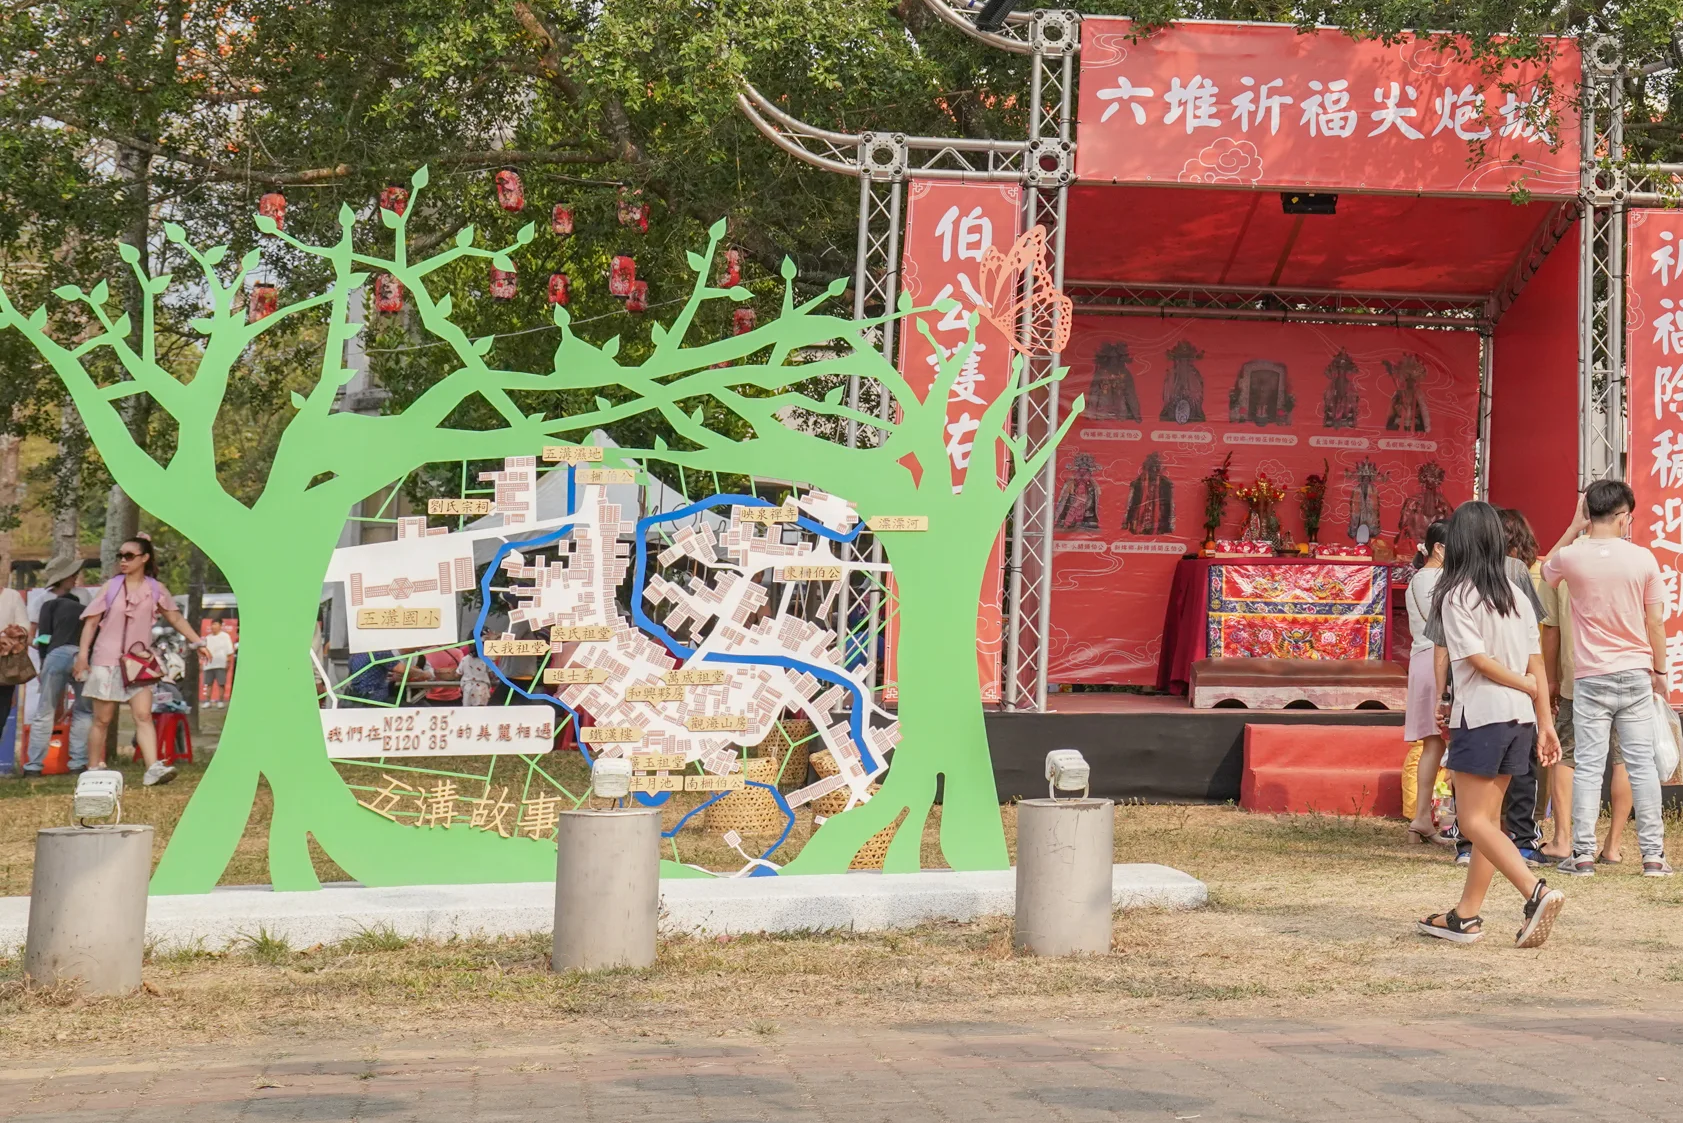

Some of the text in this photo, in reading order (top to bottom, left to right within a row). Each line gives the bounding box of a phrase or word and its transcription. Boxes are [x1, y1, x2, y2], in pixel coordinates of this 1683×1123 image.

[1097, 74, 1557, 145] 六堆祈福尖炮城
[544, 447, 602, 461] 五溝濕地
[429, 499, 490, 514] 劉氏宗祠
[741, 506, 797, 521] 映泉禪寺
[786, 566, 841, 580] 東柵伯公
[359, 609, 439, 629] 五溝國小
[553, 627, 611, 641] 吳氏祖堂
[552, 669, 594, 682] 進士第
[668, 671, 724, 684] 萬成祖堂
[628, 686, 685, 701] 和興夥房
[691, 717, 747, 730] 觀海山房
[327, 726, 382, 743] 我們在
[456, 722, 552, 742] 的美麗相遇
[589, 728, 634, 742] 鐵漢樓
[631, 776, 676, 790] 半月池
[686, 776, 743, 790] 南柵伯公
[358, 774, 562, 841] 五溝故事
